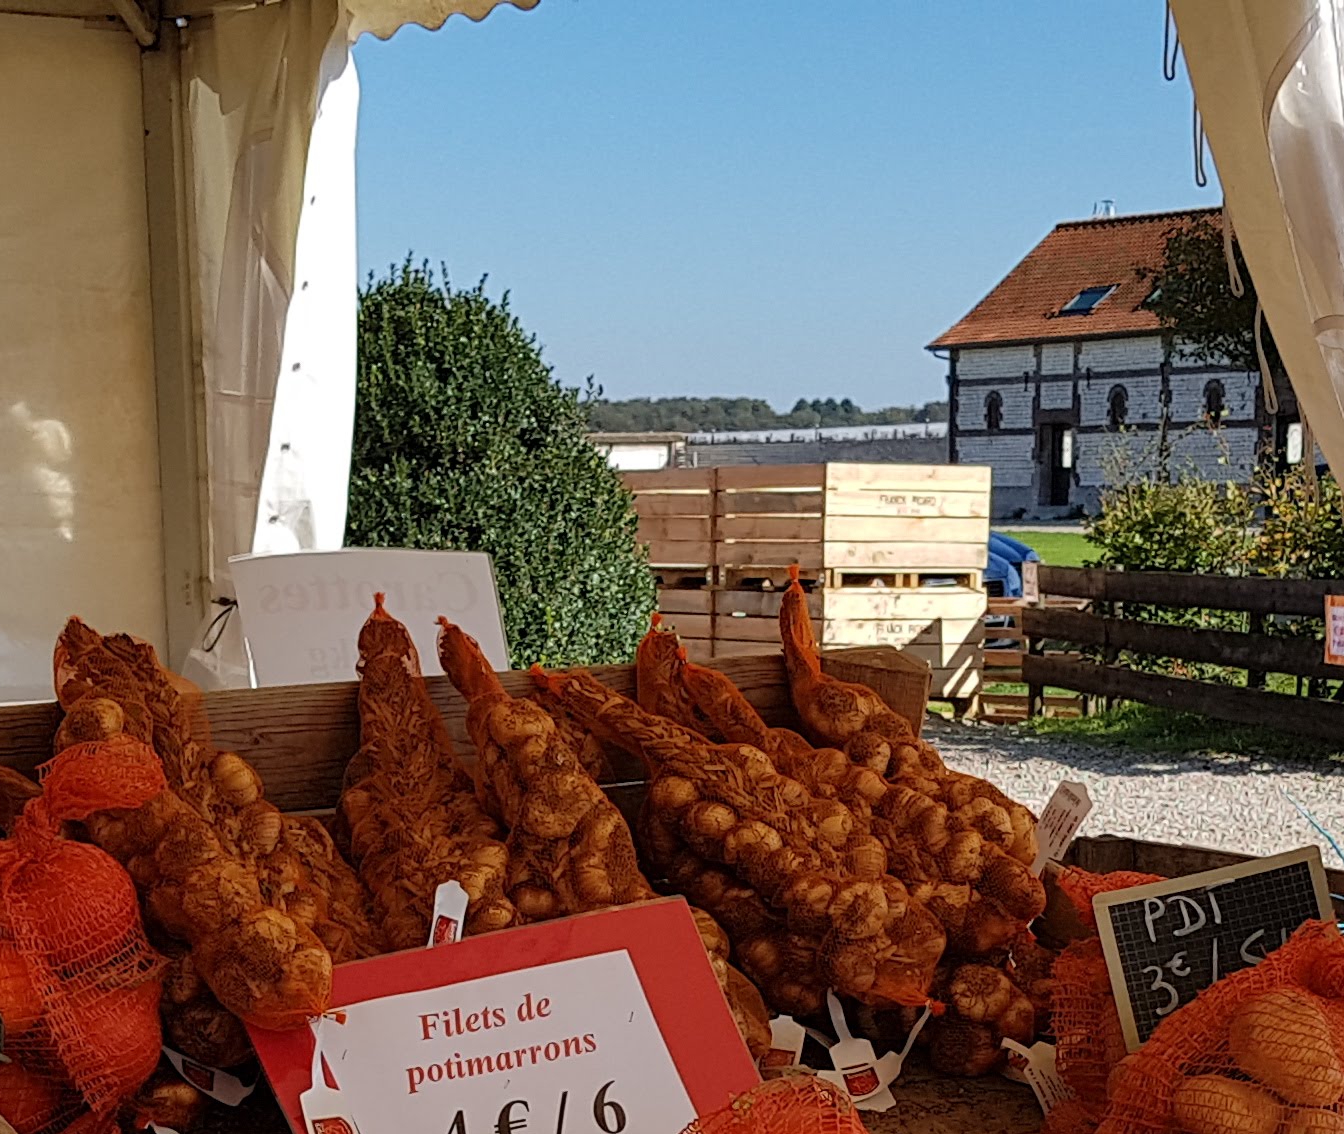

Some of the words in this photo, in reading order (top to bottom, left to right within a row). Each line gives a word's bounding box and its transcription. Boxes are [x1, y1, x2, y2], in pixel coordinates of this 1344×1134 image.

[417, 1006, 506, 1041] Filets
[517, 993, 552, 1022] de
[405, 1033, 597, 1094] potimarrons
[592, 1079, 627, 1134] 6
